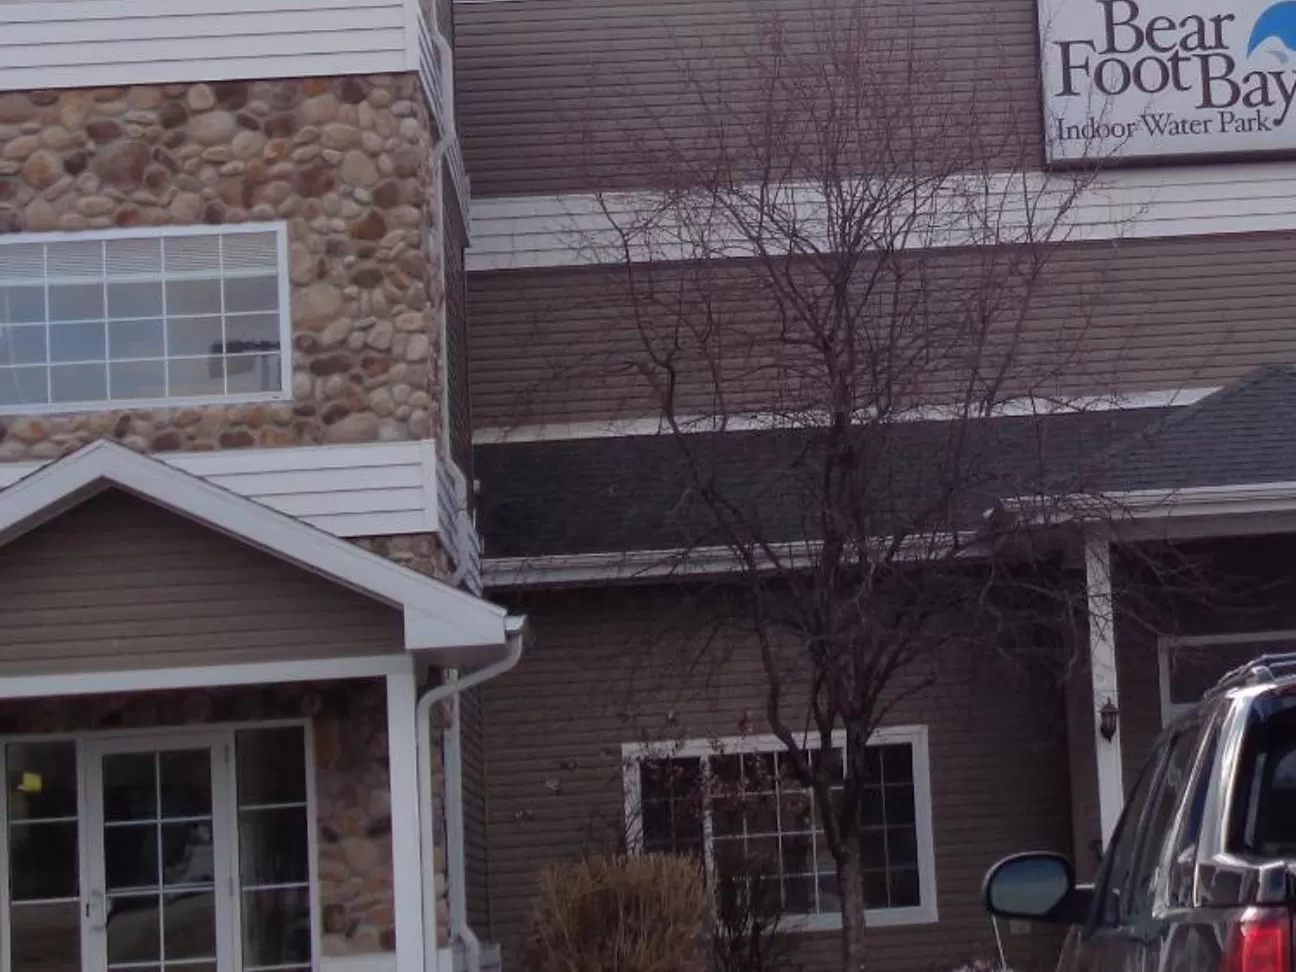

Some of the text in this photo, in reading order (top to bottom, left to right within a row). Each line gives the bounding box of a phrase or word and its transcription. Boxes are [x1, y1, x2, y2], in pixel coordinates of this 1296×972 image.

[1052, 39, 1193, 97] Foot
[1055, 109, 1273, 141] Indoor Water Park
